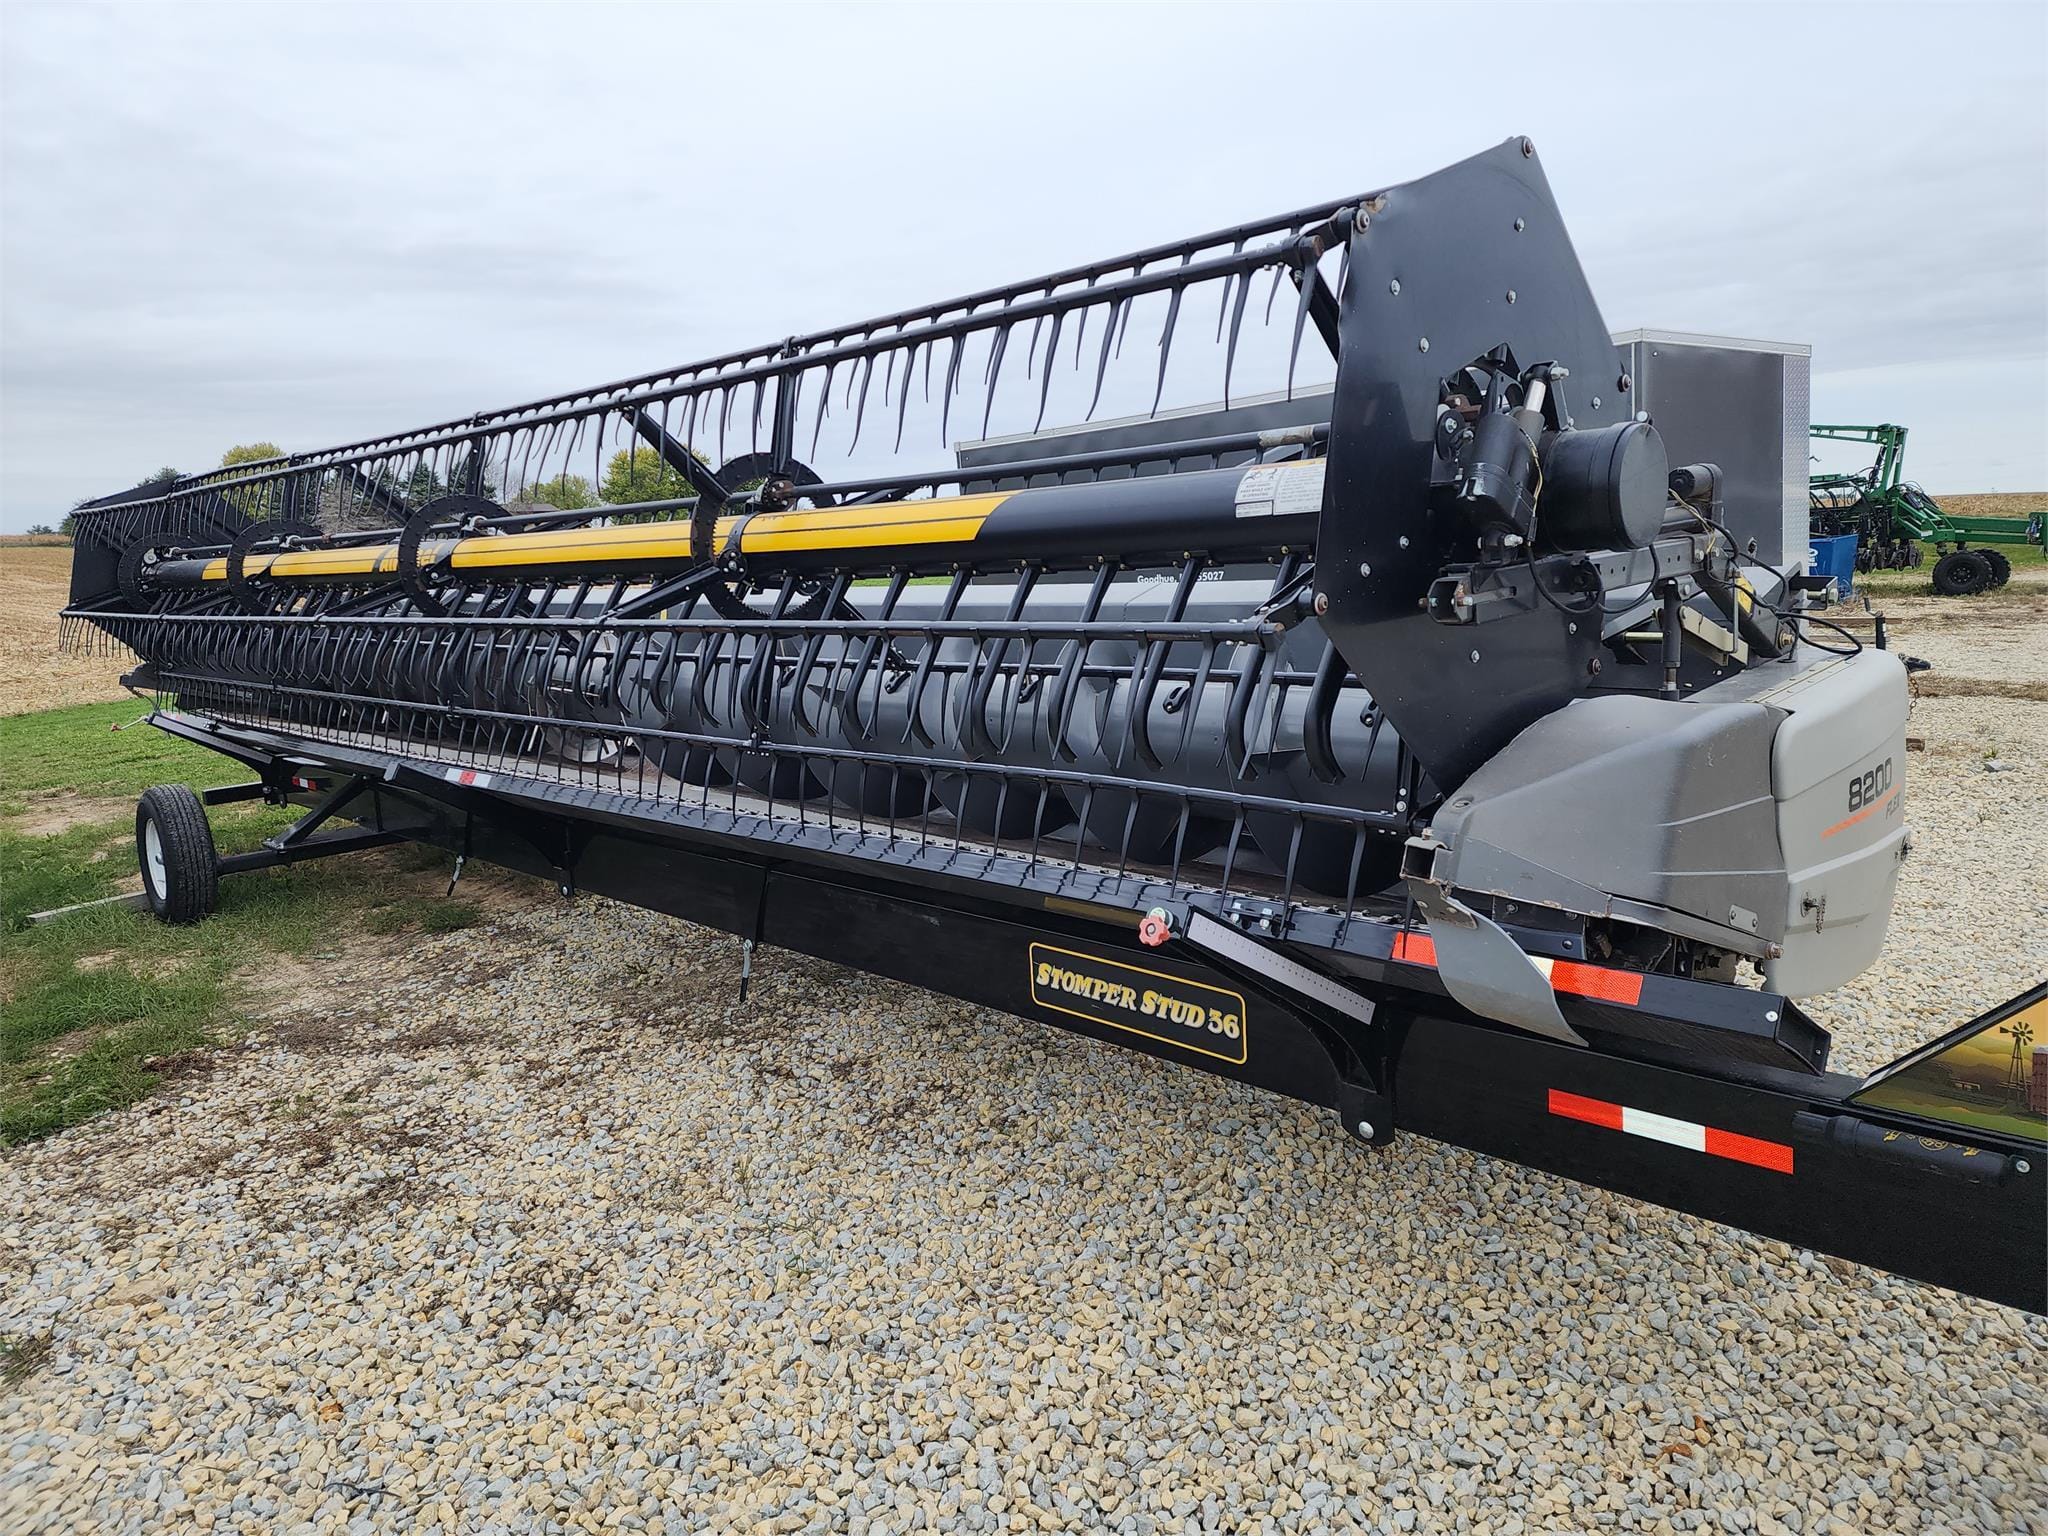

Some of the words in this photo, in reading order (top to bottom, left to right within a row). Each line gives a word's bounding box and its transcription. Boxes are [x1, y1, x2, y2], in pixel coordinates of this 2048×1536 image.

[1137, 574, 1177, 584] Goodhue,
[1849, 758, 1892, 812] 8200
[1207, 1007, 1241, 1039] 36
